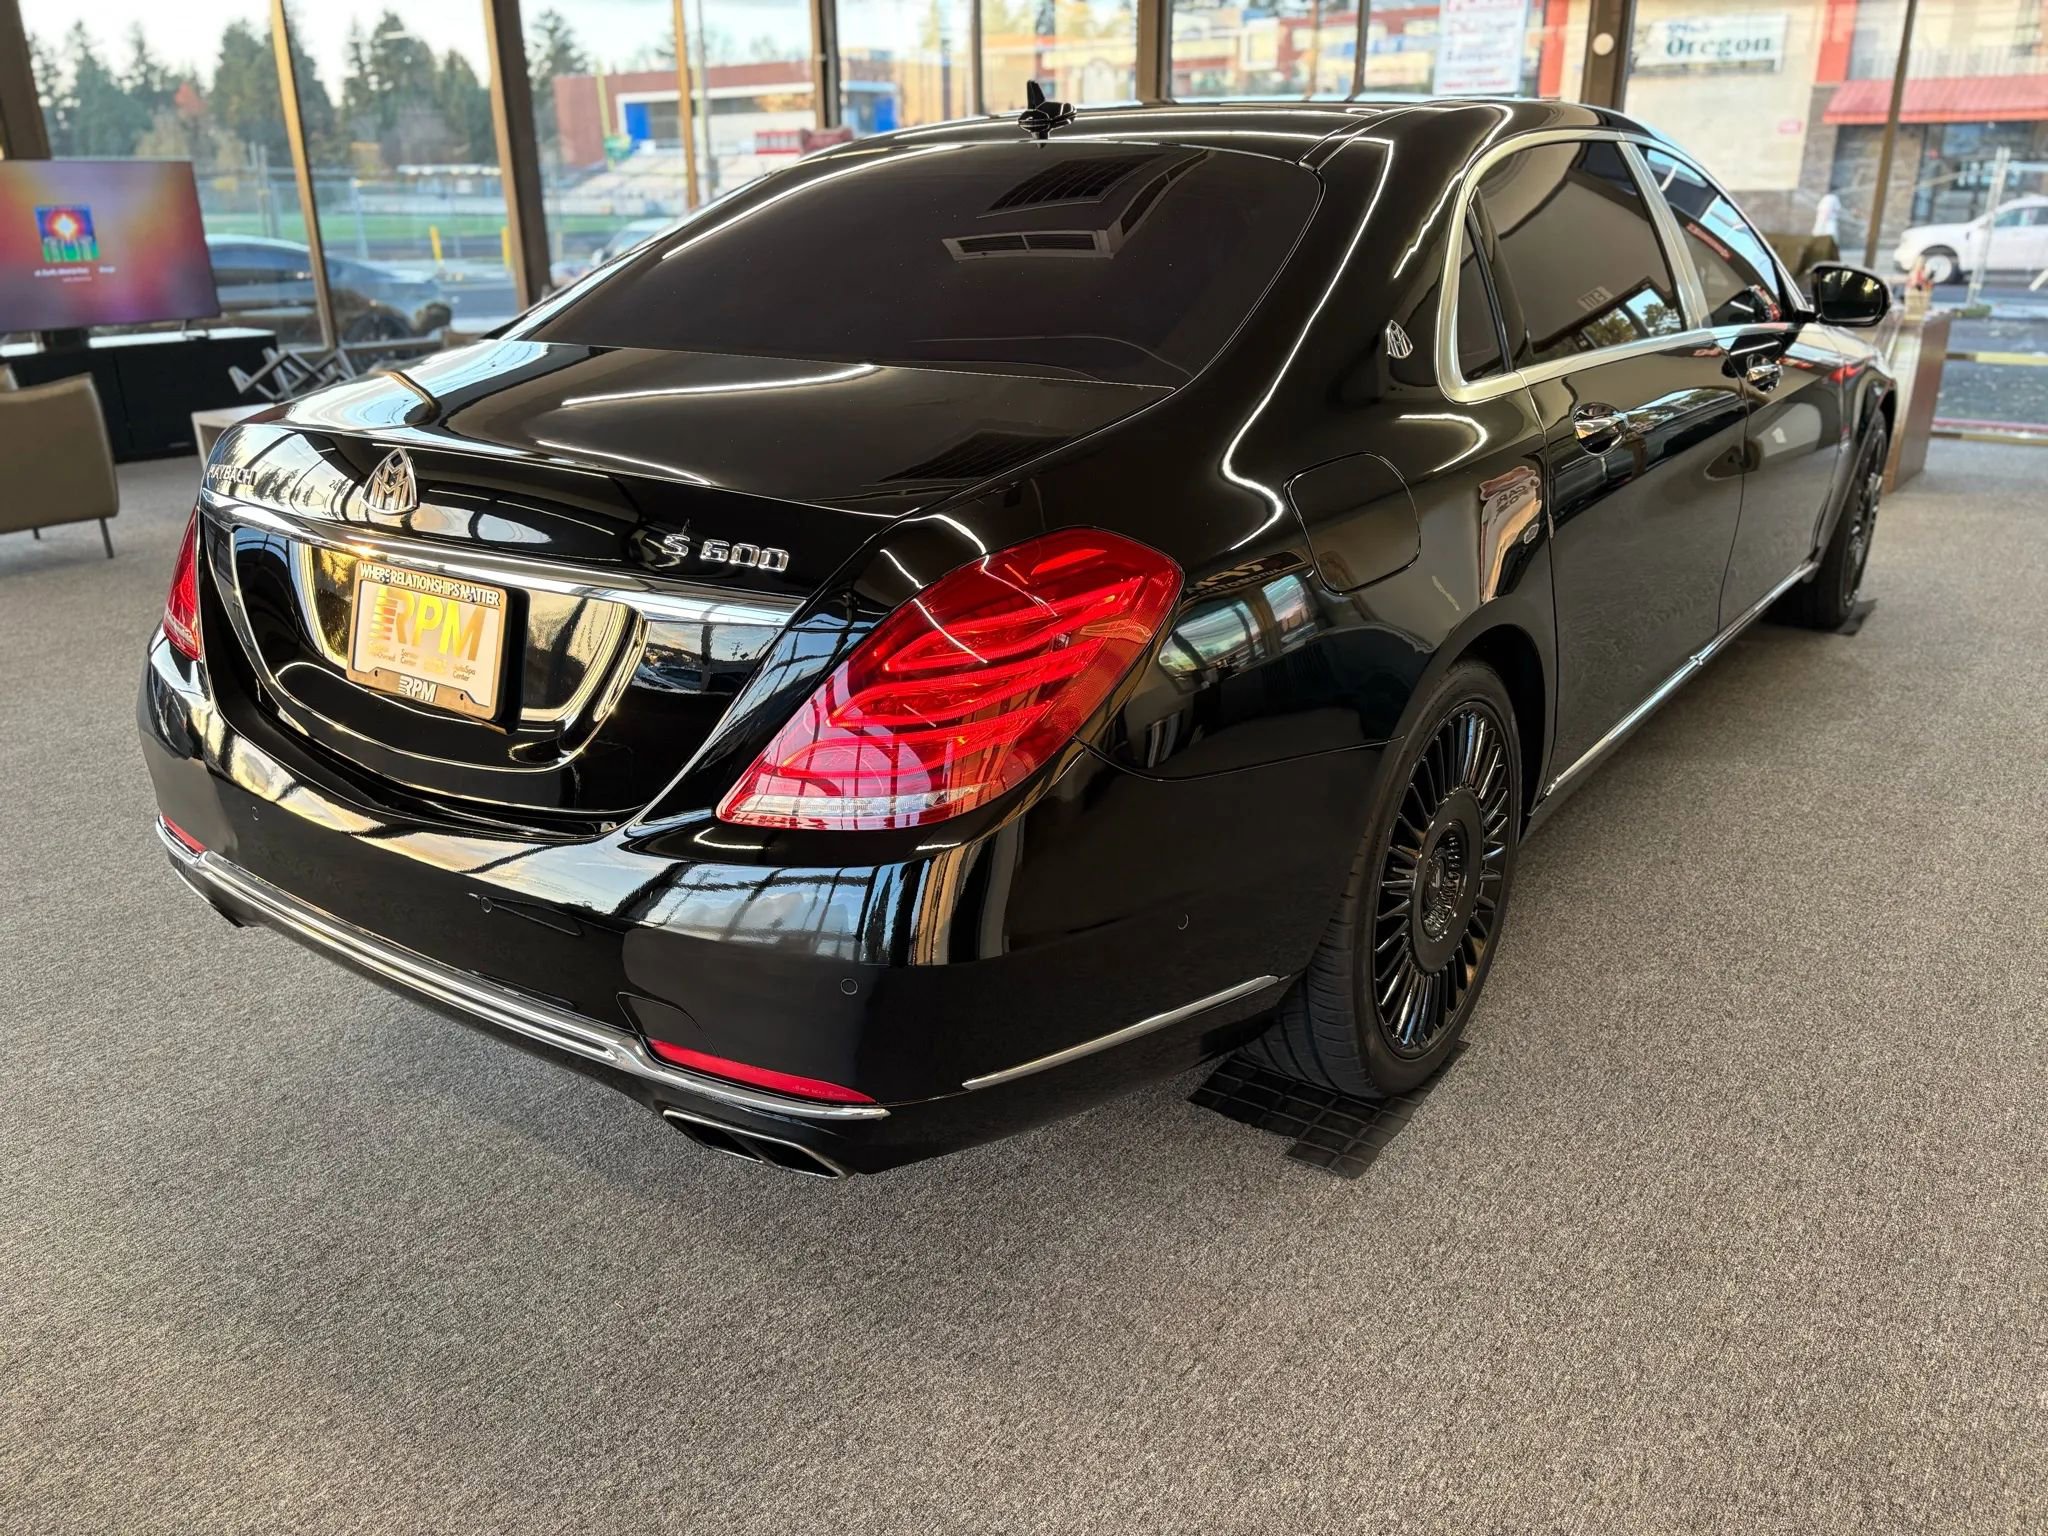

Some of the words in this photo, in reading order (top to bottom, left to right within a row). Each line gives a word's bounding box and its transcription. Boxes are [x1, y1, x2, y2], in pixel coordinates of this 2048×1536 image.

[1666, 37, 1772, 57] Oregon
[207, 464, 258, 486] MAYBACH
[662, 533, 690, 557] S
[699, 538, 789, 572] 600
[360, 563, 391, 584] WHERE
[390, 570, 460, 597] RELATIONSHIPS
[460, 584, 500, 606] MATTER
[368, 586, 488, 661] RPM
[398, 675, 438, 703] RPM
